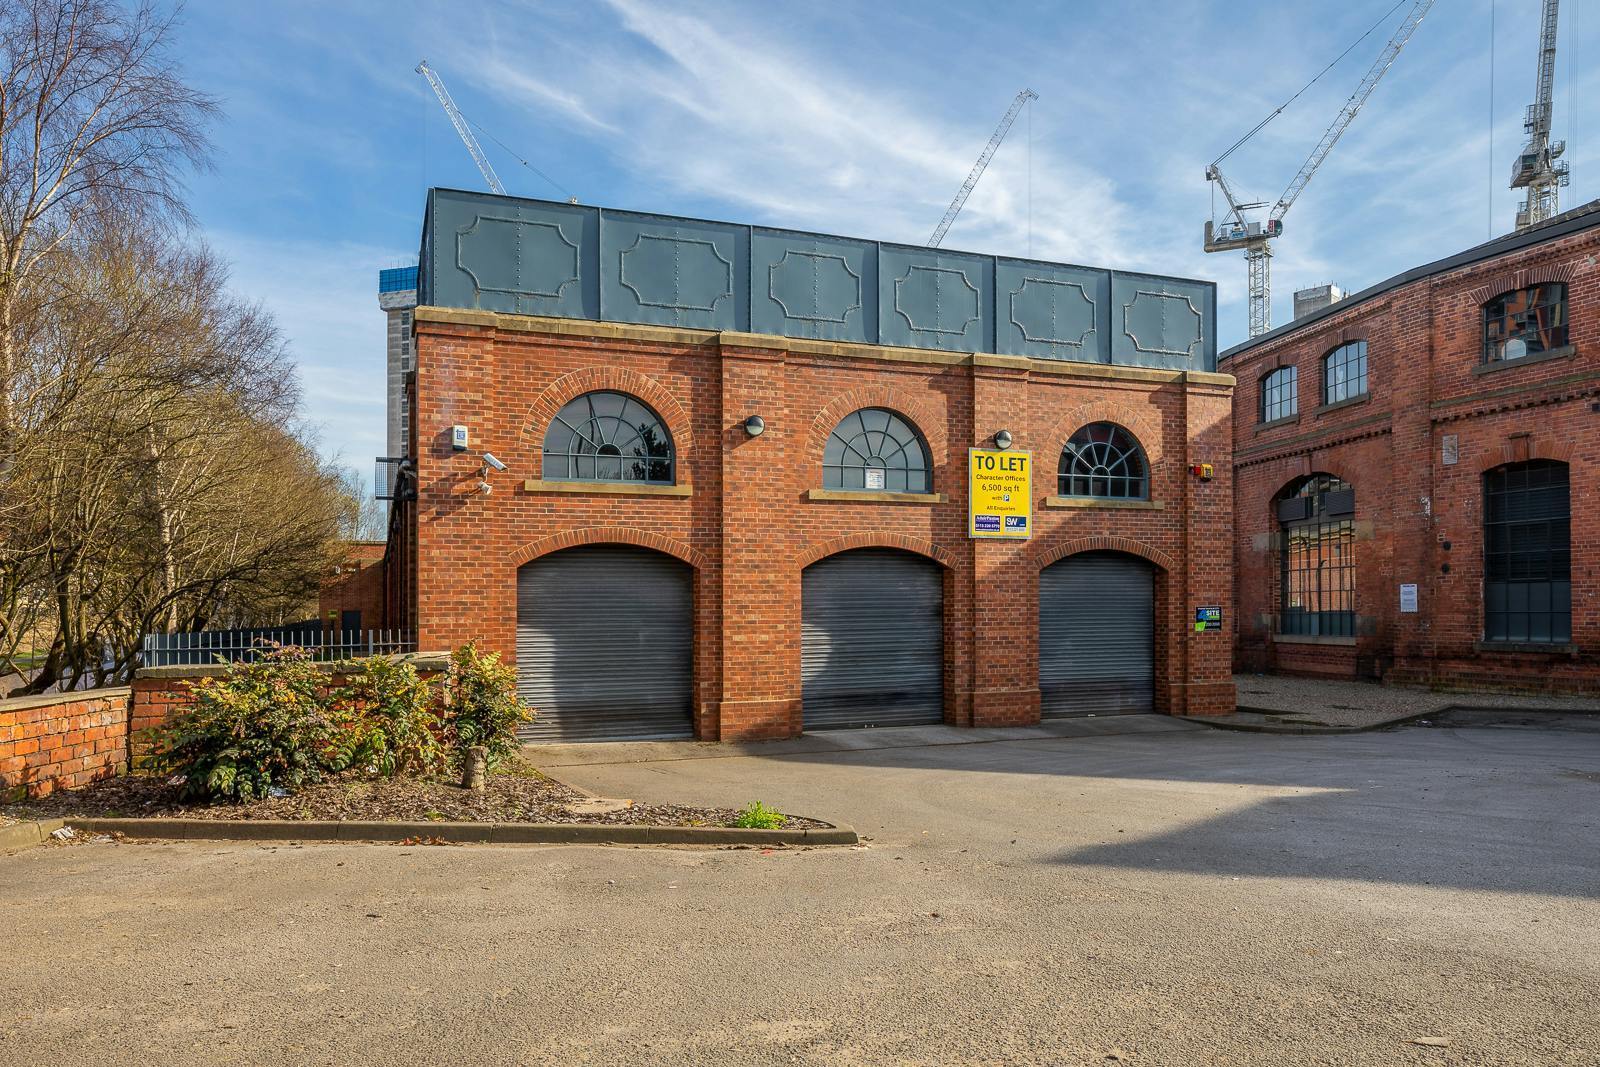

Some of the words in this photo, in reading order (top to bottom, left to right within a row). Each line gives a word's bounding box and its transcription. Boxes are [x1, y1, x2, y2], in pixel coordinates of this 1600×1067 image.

[975, 456, 995, 470] TO
[1000, 457, 1026, 471] LET
[976, 473, 1003, 481] Character
[982, 483, 1001, 492] 6,500
[1003, 485, 1012, 493] sq
